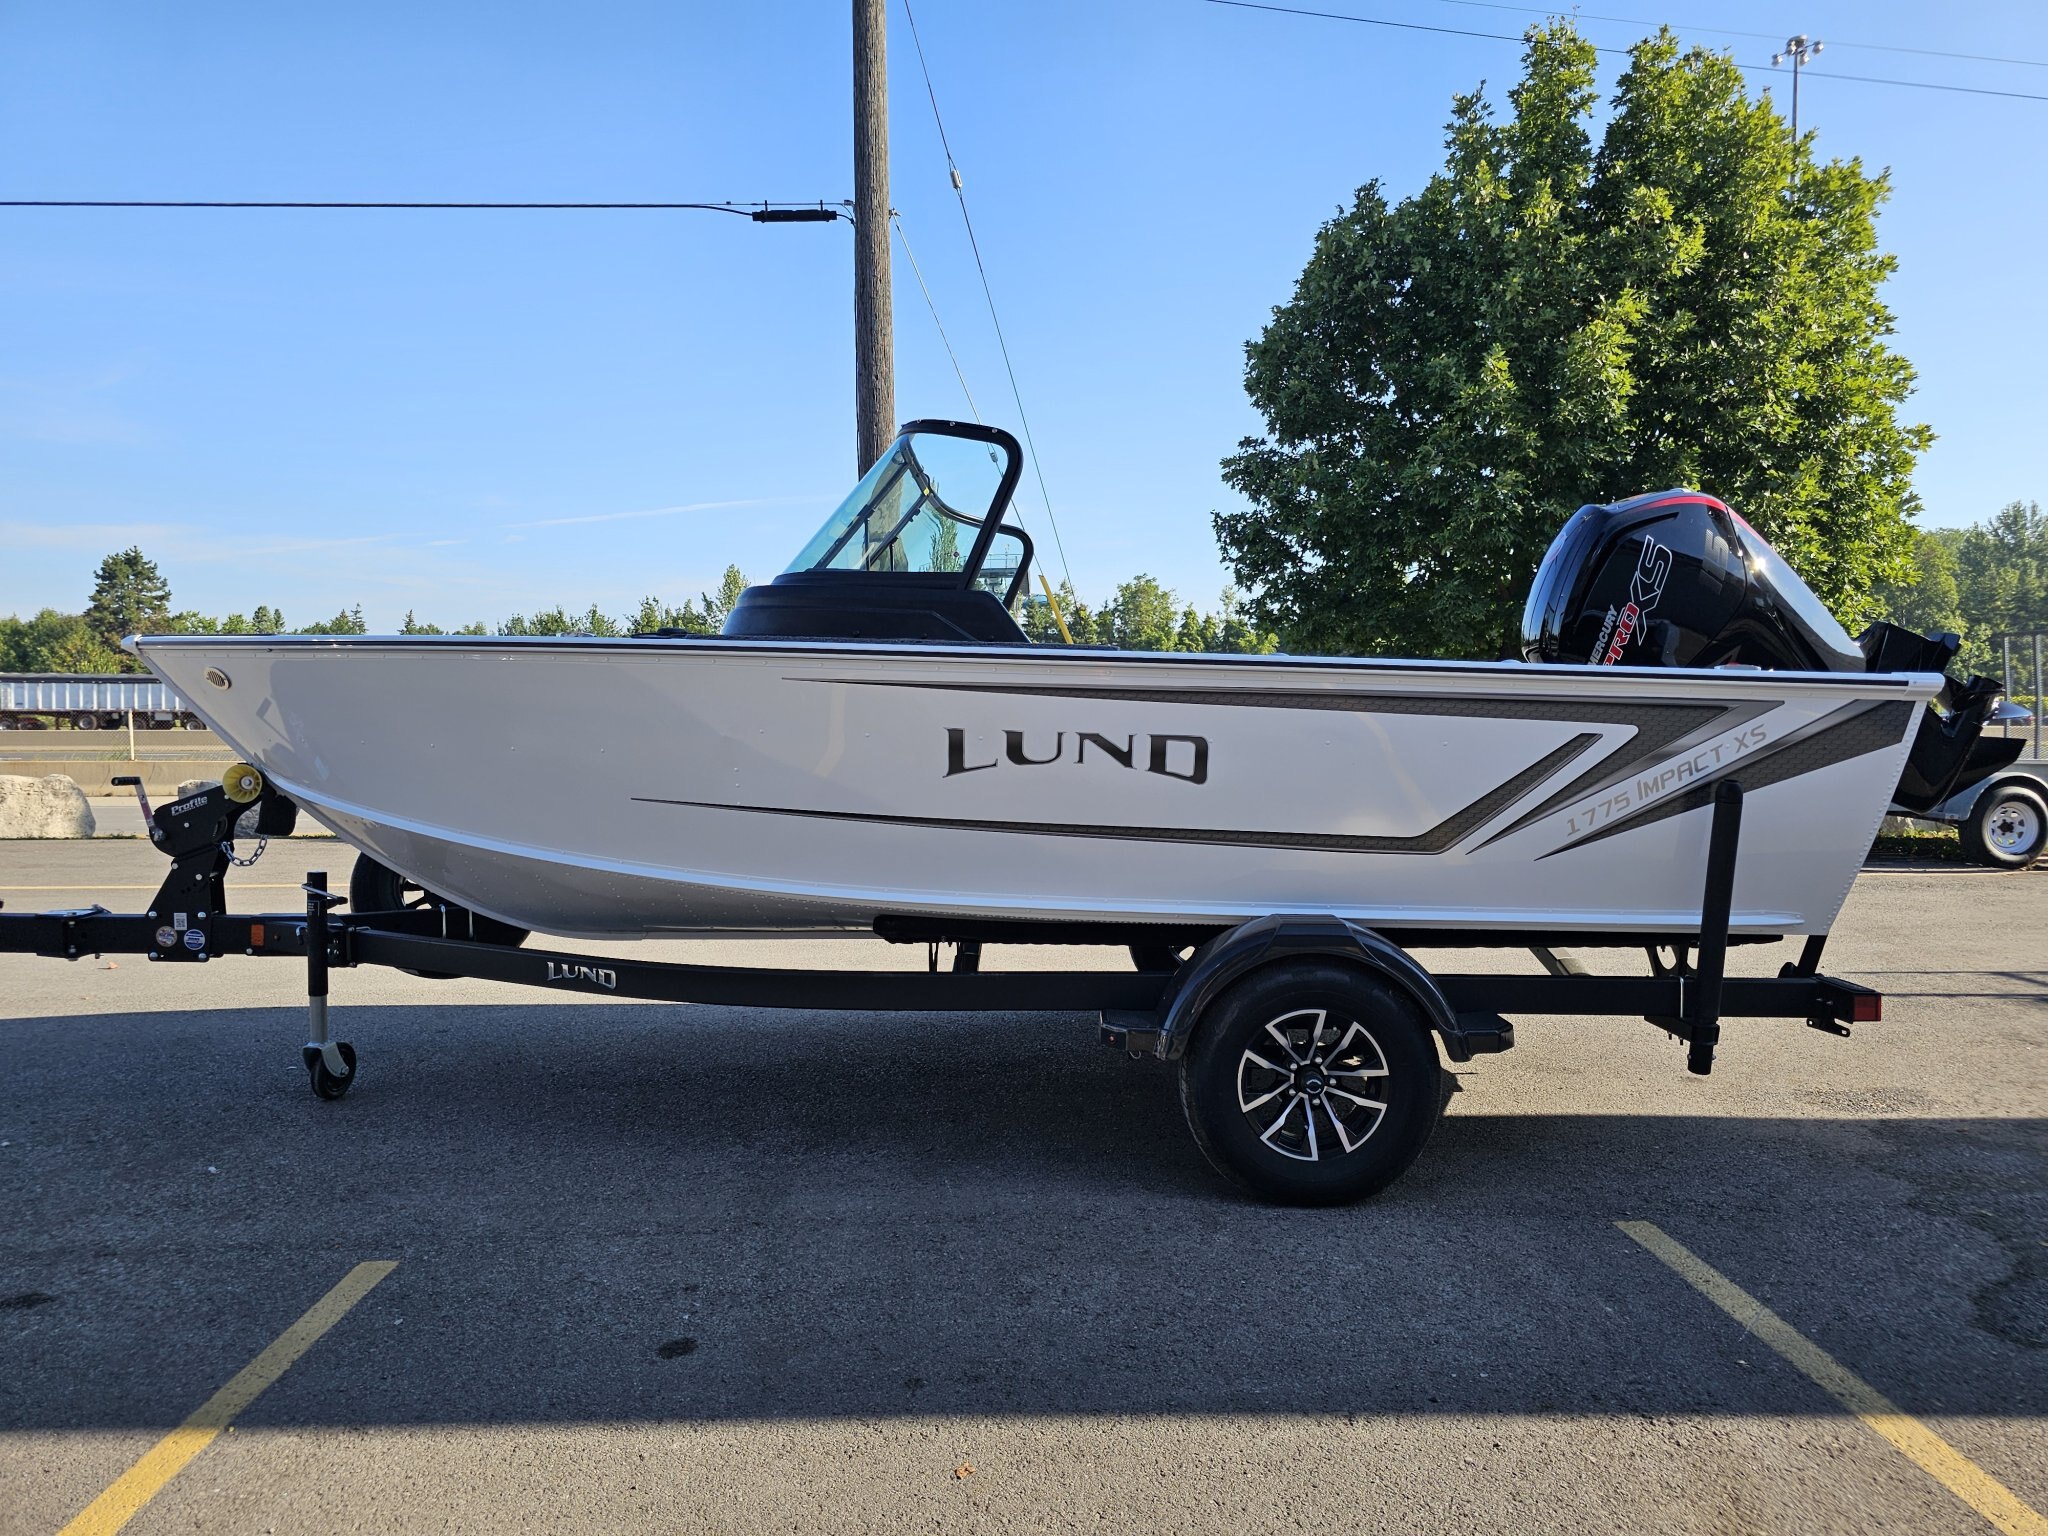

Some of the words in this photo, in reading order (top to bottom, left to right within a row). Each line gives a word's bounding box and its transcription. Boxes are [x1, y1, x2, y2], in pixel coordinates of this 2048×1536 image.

[1630, 534, 1672, 646] XS
[1588, 604, 1617, 665] MERCURY
[943, 727, 1209, 785] LUND
[1566, 791, 1631, 837] 1775
[1636, 744, 1725, 801] IMPACT
[1733, 723, 1767, 753] XS
[171, 796, 208, 814] Profile
[546, 961, 617, 990] LUND
